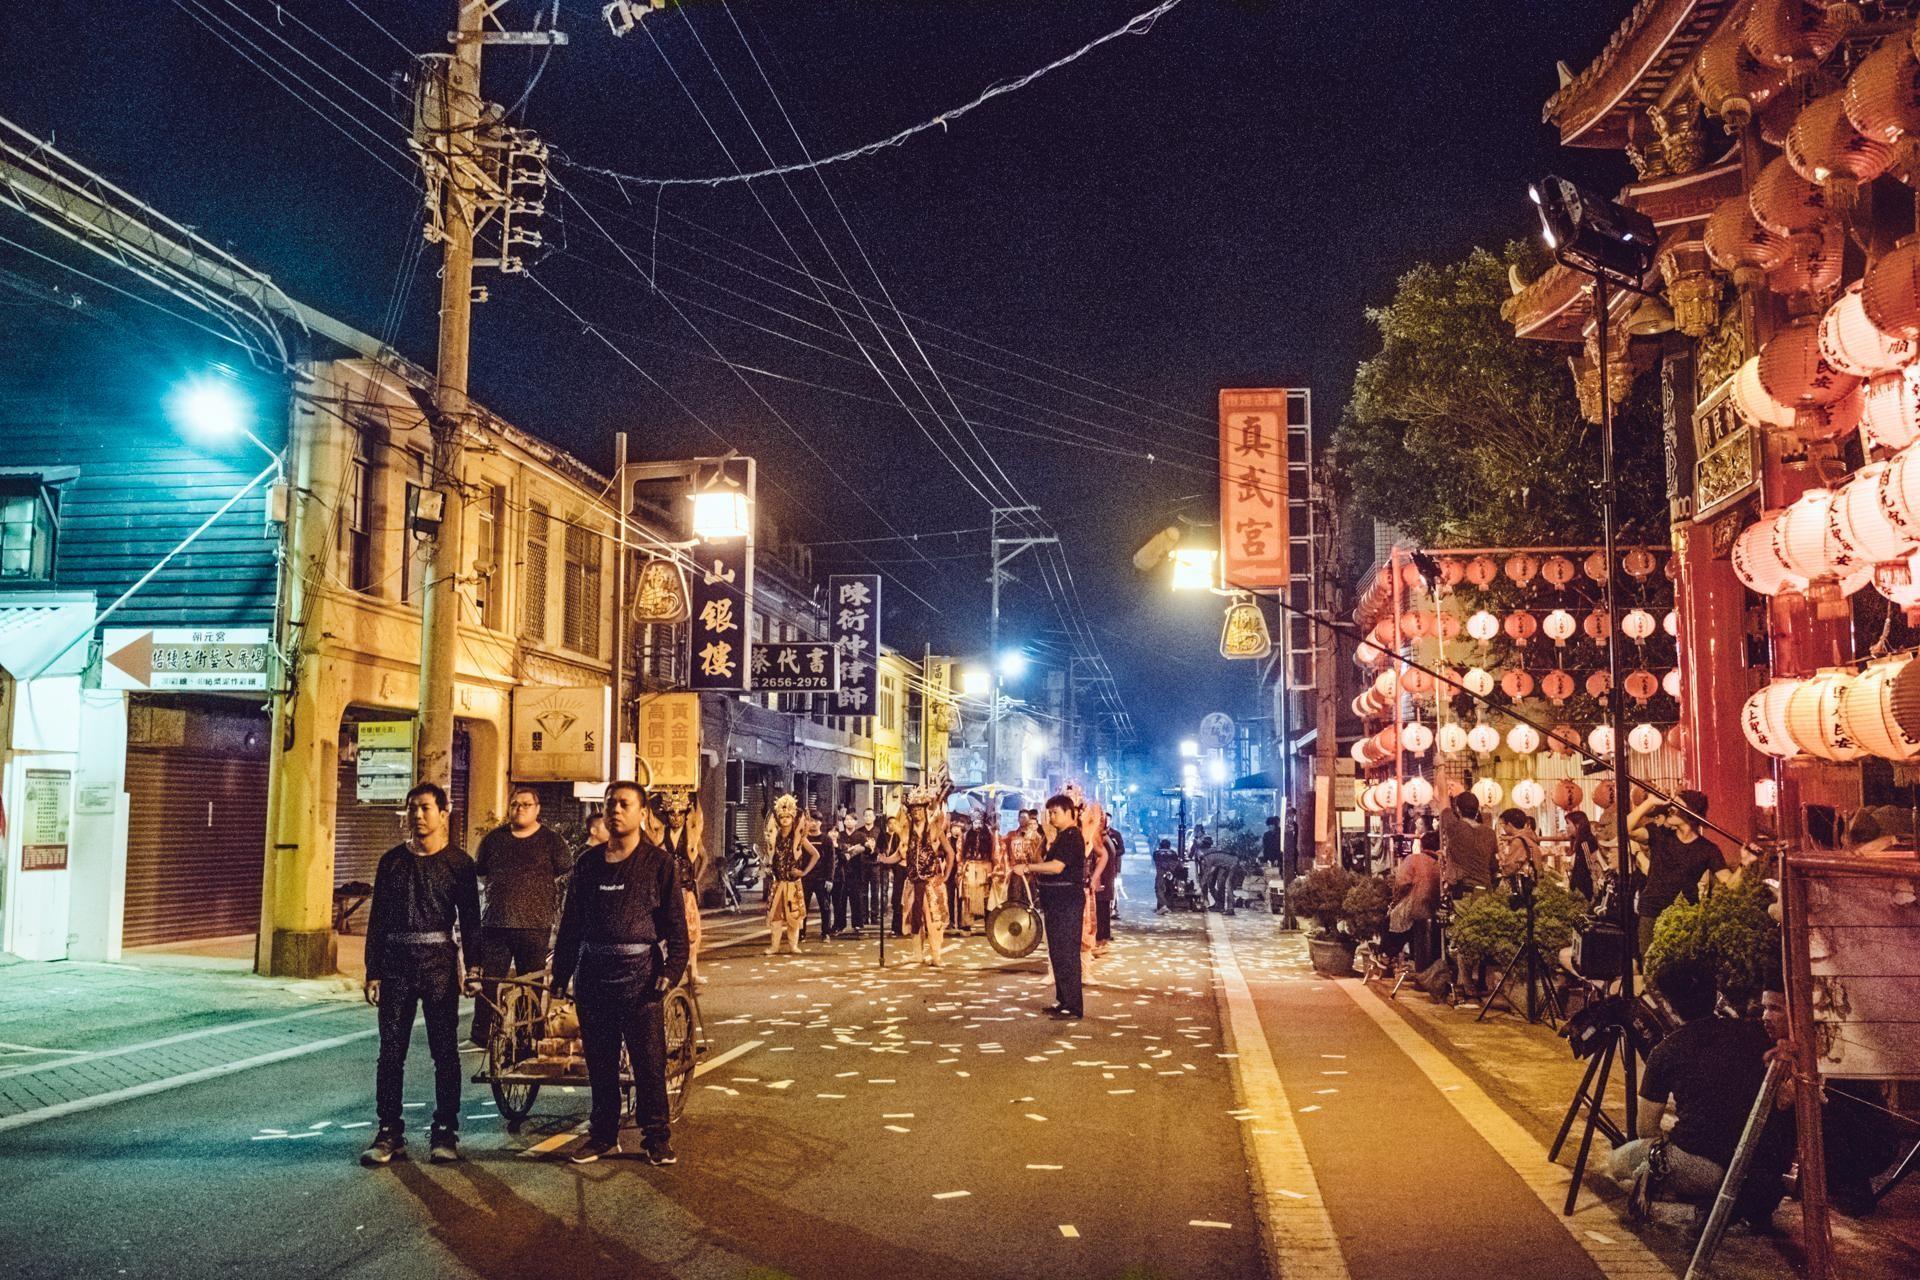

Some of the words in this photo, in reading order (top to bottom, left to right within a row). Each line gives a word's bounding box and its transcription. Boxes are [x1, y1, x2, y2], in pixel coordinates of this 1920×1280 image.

[1235, 415, 1274, 558] 真武宮
[762, 677, 828, 687] 2656-2976
[583, 730, 595, 752] K金
[671, 702, 689, 778] 黃金買賣
